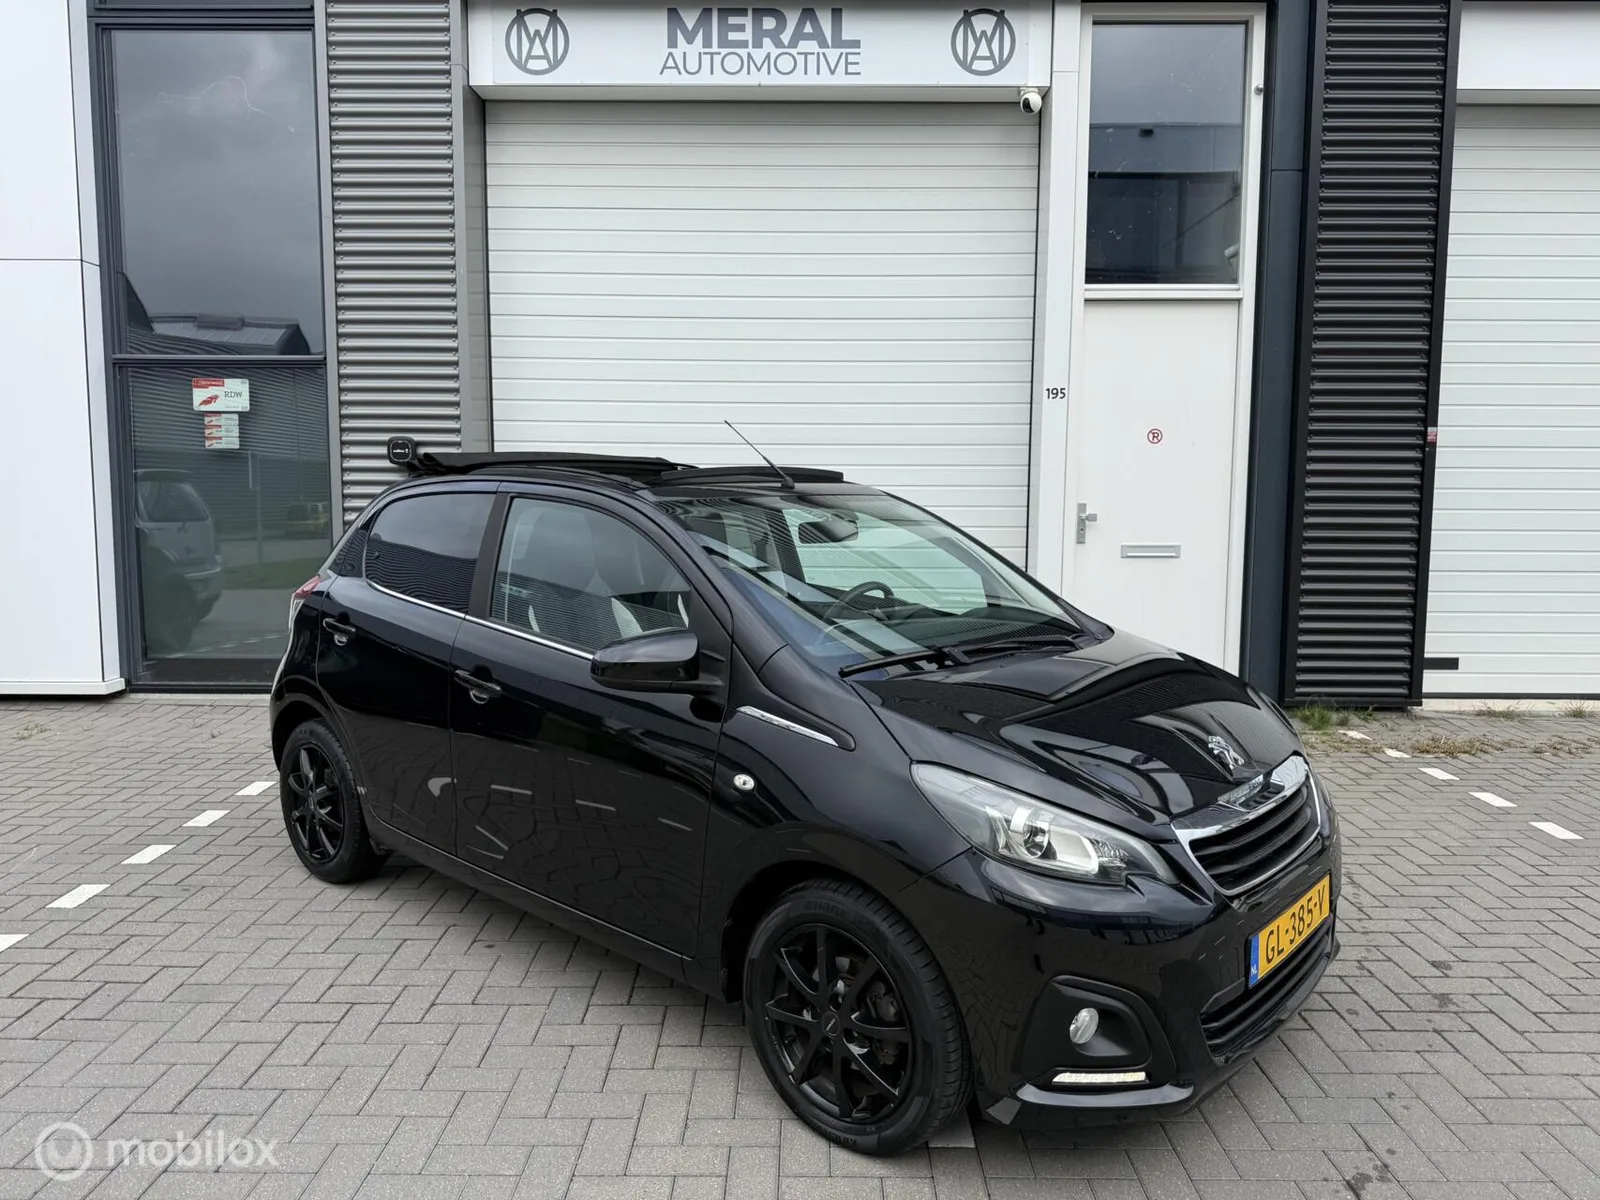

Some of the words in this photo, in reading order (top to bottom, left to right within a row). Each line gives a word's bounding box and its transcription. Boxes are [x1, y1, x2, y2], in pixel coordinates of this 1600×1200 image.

[667, 8, 861, 49] MERAL
[659, 51, 861, 76] AUTOMOTIVE
[1045, 387, 1066, 400] 195
[1265, 884, 1326, 965] GL-385-V
